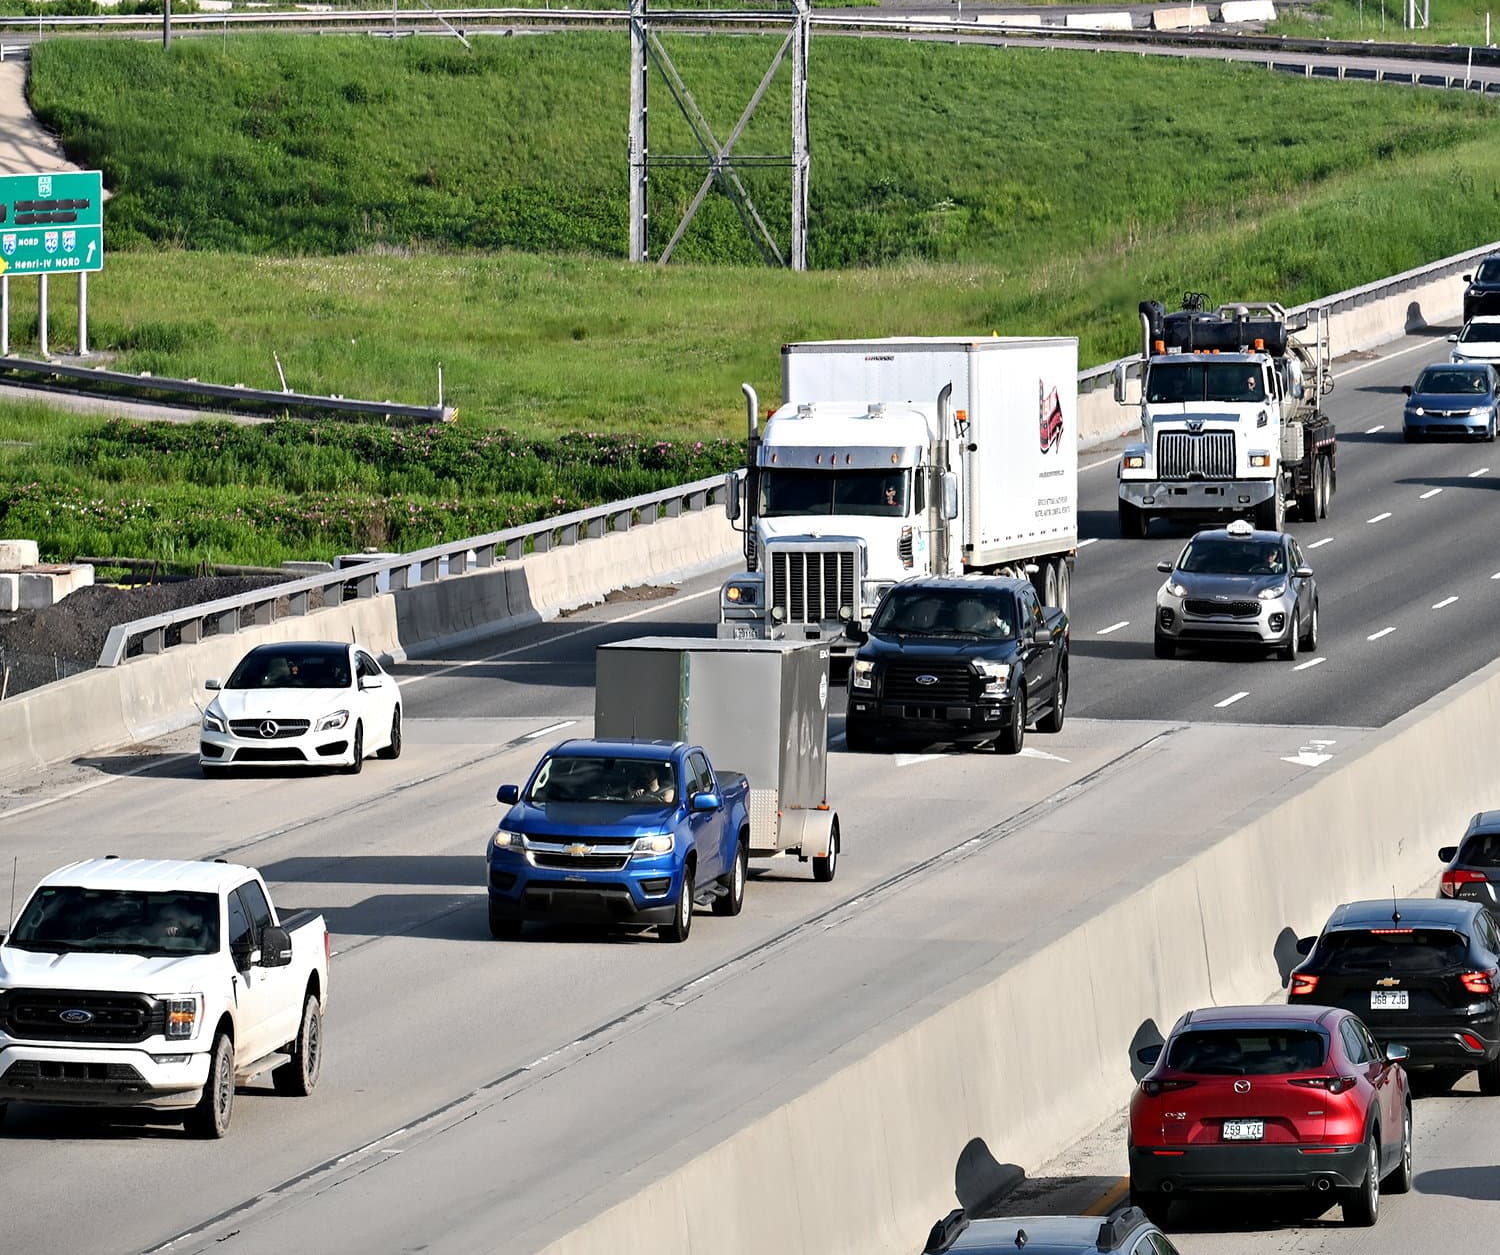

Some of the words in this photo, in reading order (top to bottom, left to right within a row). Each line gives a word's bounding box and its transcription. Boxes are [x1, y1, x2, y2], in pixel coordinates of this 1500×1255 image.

[18, 237, 39, 246] NORD
[15, 258, 52, 269] Henri-IV
[55, 257, 80, 267] NORD
[1224, 1124, 1241, 1136] Z59
[1246, 1124, 1263, 1135] YZE
